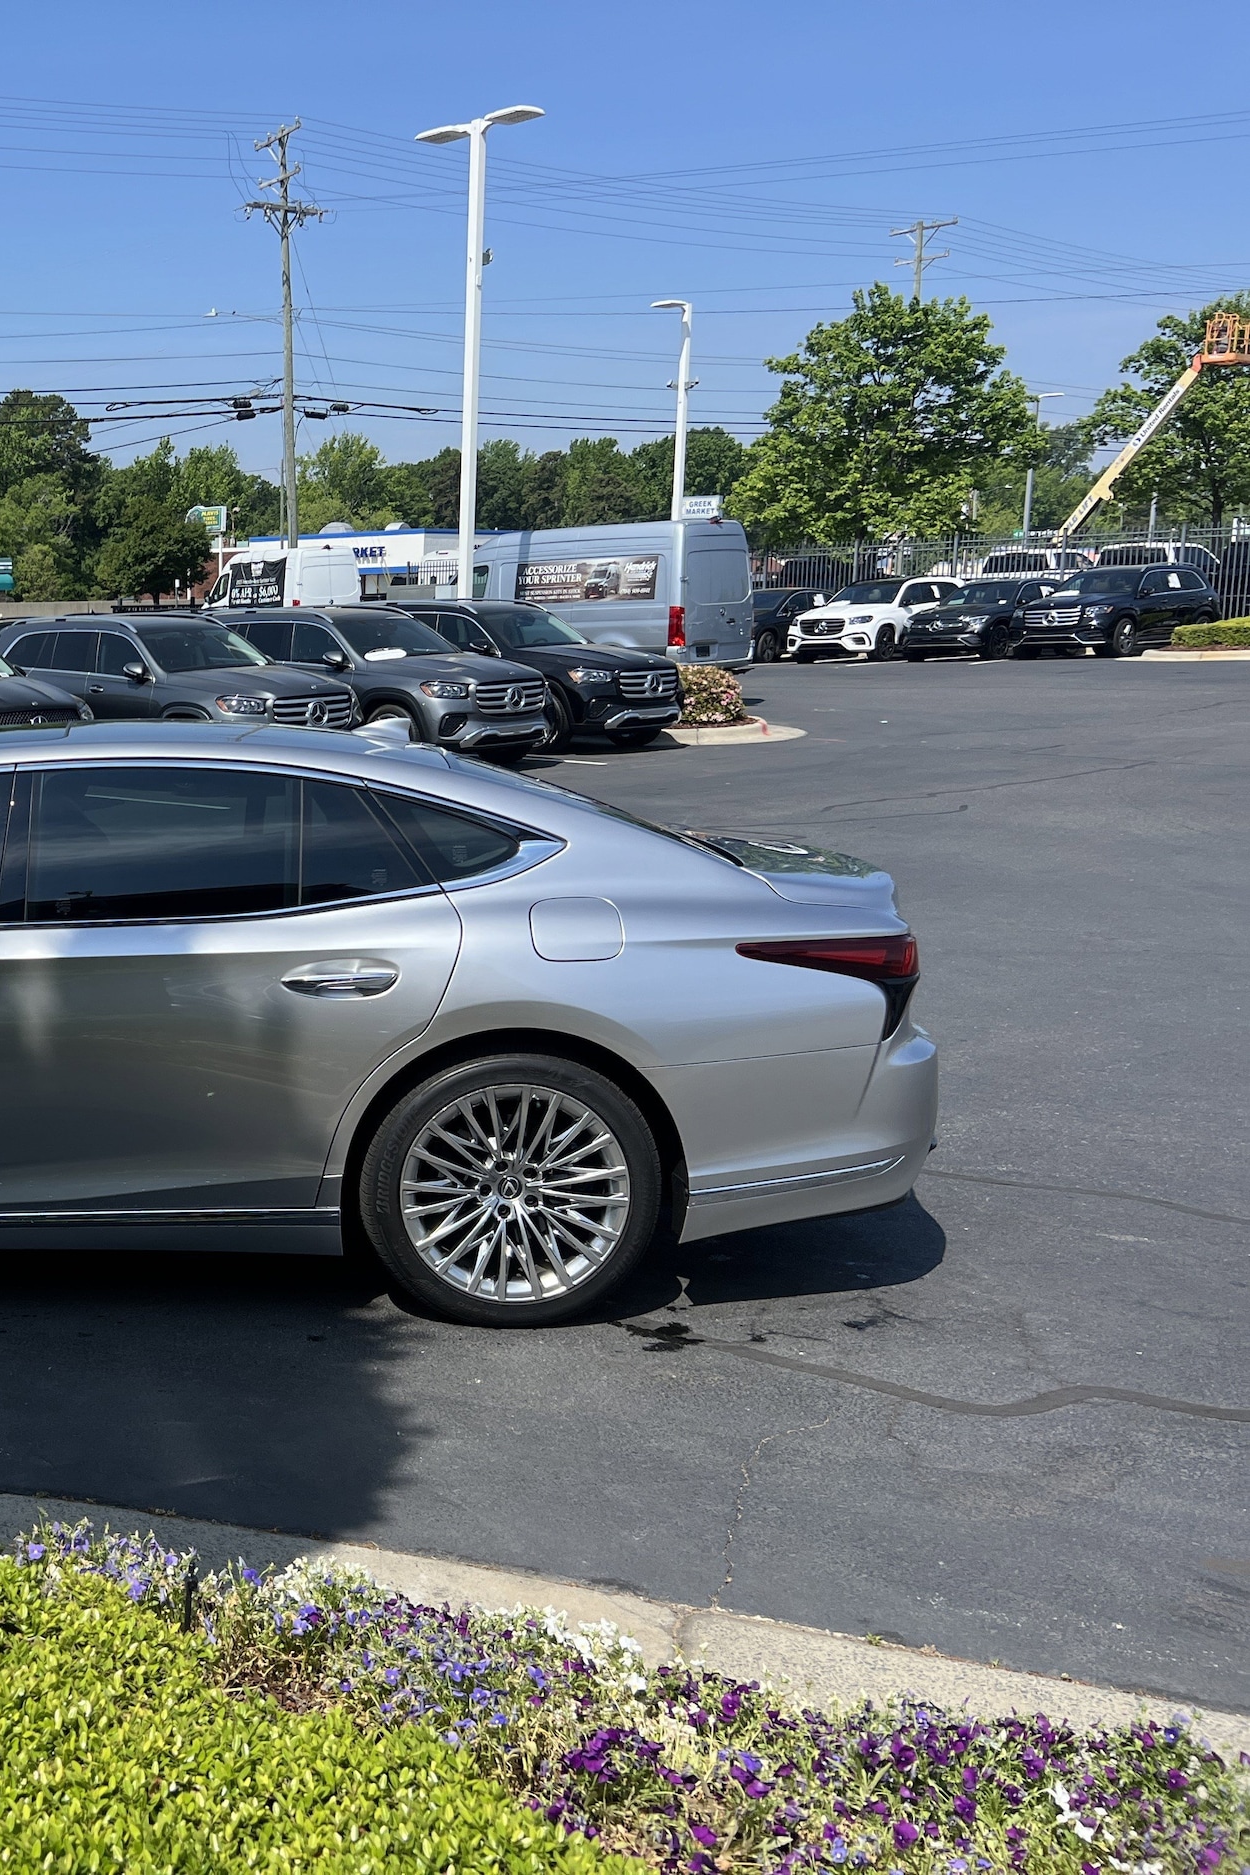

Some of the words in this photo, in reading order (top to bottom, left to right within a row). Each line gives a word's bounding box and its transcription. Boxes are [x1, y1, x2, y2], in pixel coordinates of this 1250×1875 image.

[1140, 414, 1160, 437] United
[1158, 389, 1180, 414] Rentals
[689, 500, 712, 508] GREEK
[1078, 495, 1094, 515] LIFT
[523, 564, 577, 575] ACCESSORIZE
[624, 561, 657, 573] Hendrick
[518, 576, 539, 585] YOUR
[541, 573, 582, 583] SPRINTER
[240, 588, 252, 598] APR
[259, 585, 278, 598] $6,000
